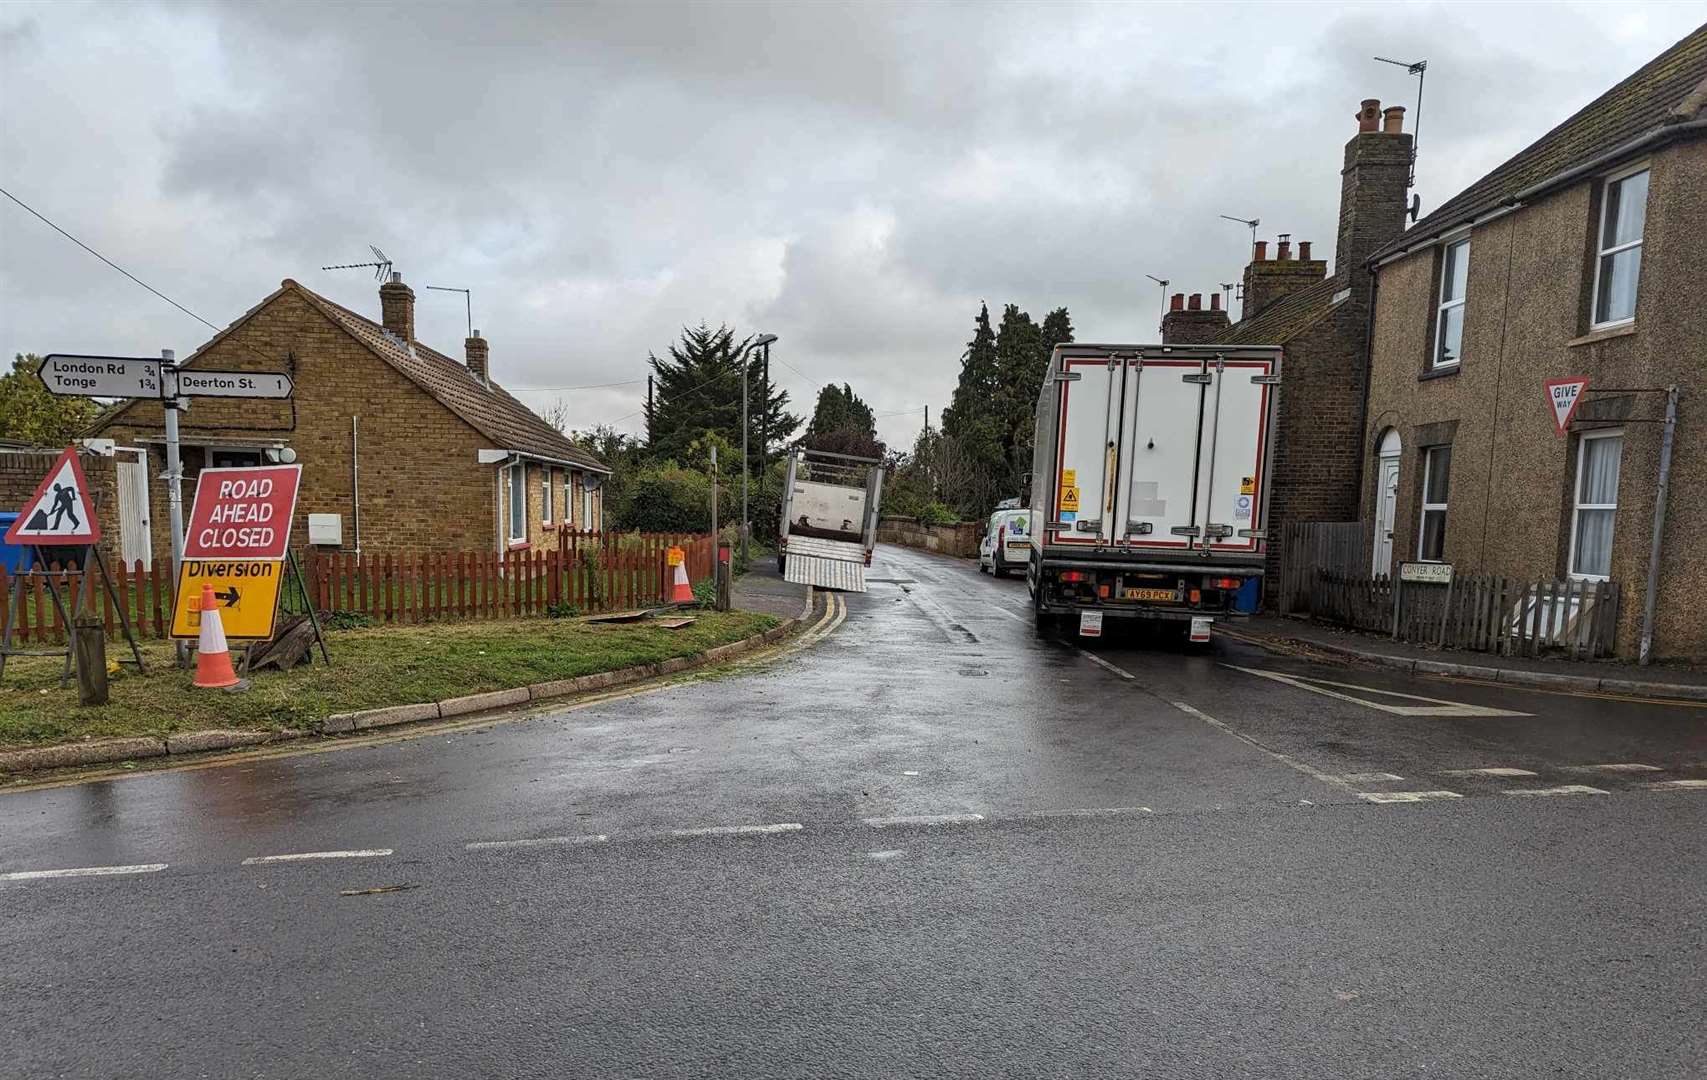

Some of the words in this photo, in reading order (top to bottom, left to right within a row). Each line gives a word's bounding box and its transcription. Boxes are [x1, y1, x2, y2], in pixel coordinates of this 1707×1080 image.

[53, 361, 104, 374] London
[107, 363, 125, 375] Rd
[54, 375, 97, 388] Tonge
[183, 377, 235, 388] Deerton
[238, 378, 257, 389] St.
[276, 380, 281, 389] 1
[1554, 385, 1578, 398] GIVE
[1556, 400, 1571, 408] WAY
[219, 479, 273, 499] ROAD
[209, 503, 273, 523] AHEAD
[199, 528, 274, 548] CLOSED
[188, 561, 272, 577] Diversion
[1402, 564, 1428, 575] CONYER
[1432, 565, 1451, 576] ROAD
